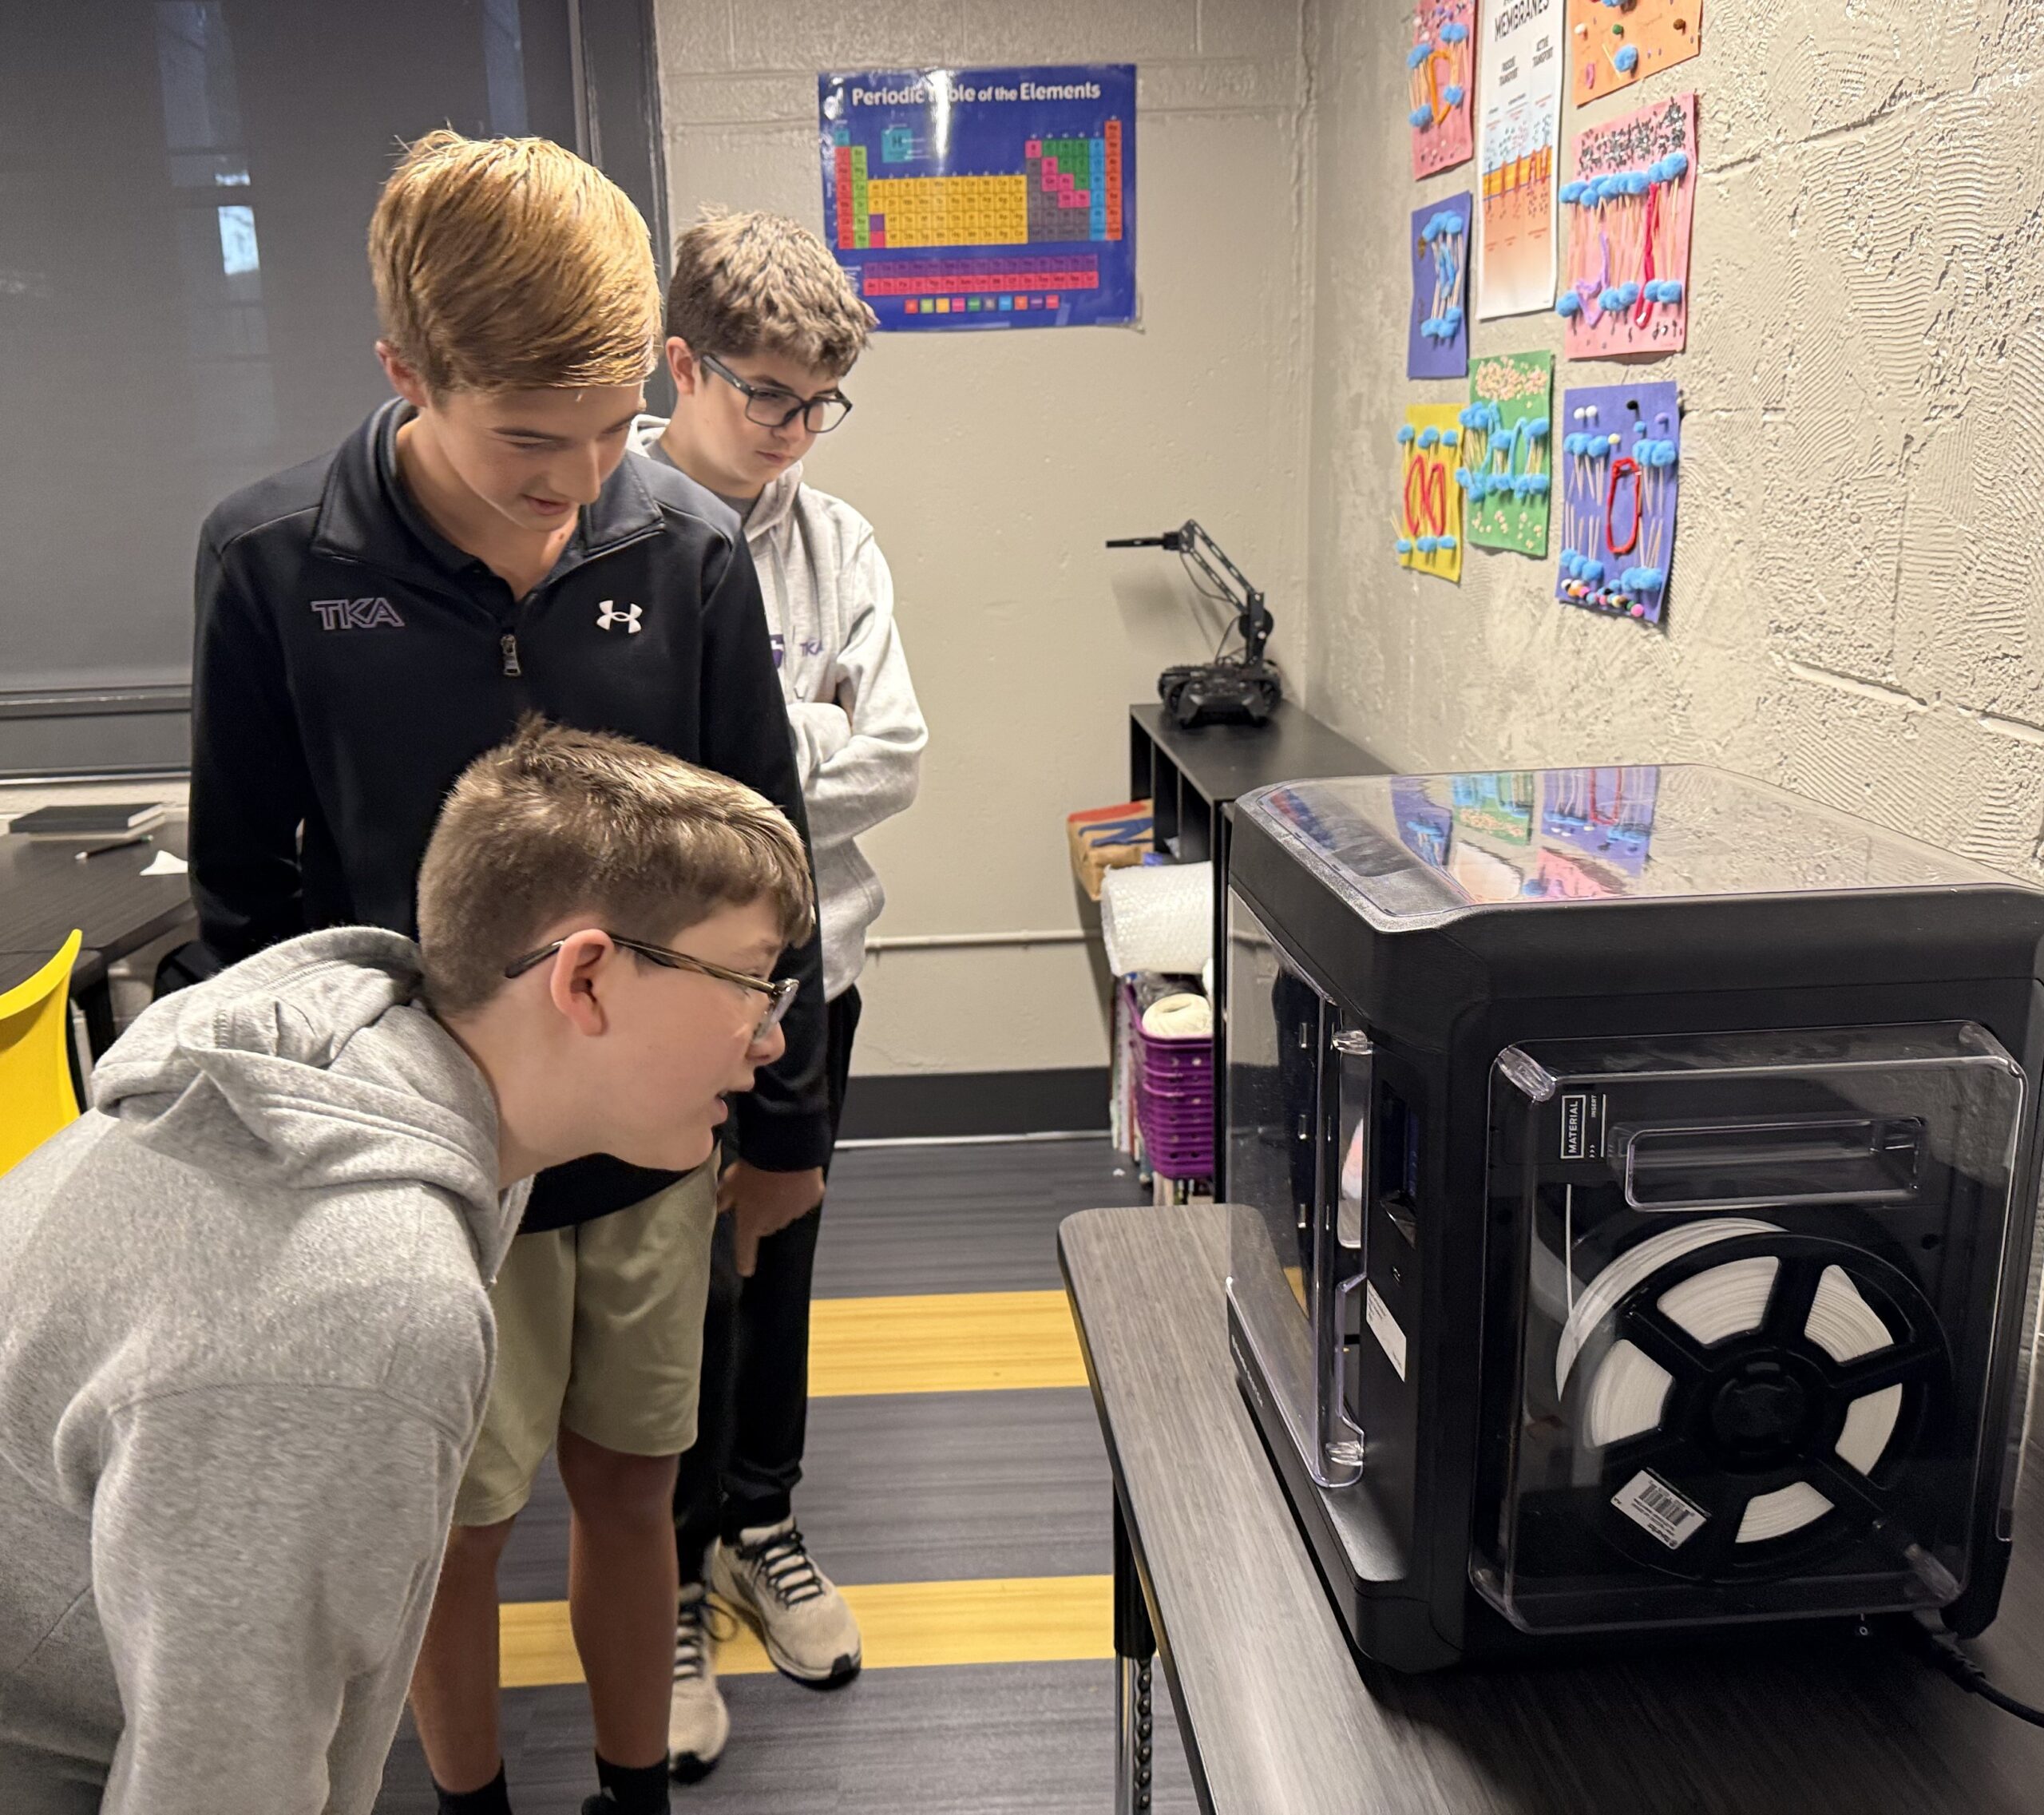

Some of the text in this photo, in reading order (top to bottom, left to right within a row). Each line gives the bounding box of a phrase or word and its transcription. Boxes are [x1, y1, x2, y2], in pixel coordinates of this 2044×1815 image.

[852, 86, 925, 106] Periodic
[977, 86, 993, 102] of
[994, 86, 1018, 101] the
[1020, 81, 1101, 101] Elements
[311, 596, 406, 631] TKA
[1568, 1100, 1579, 1154] MATERIAL
